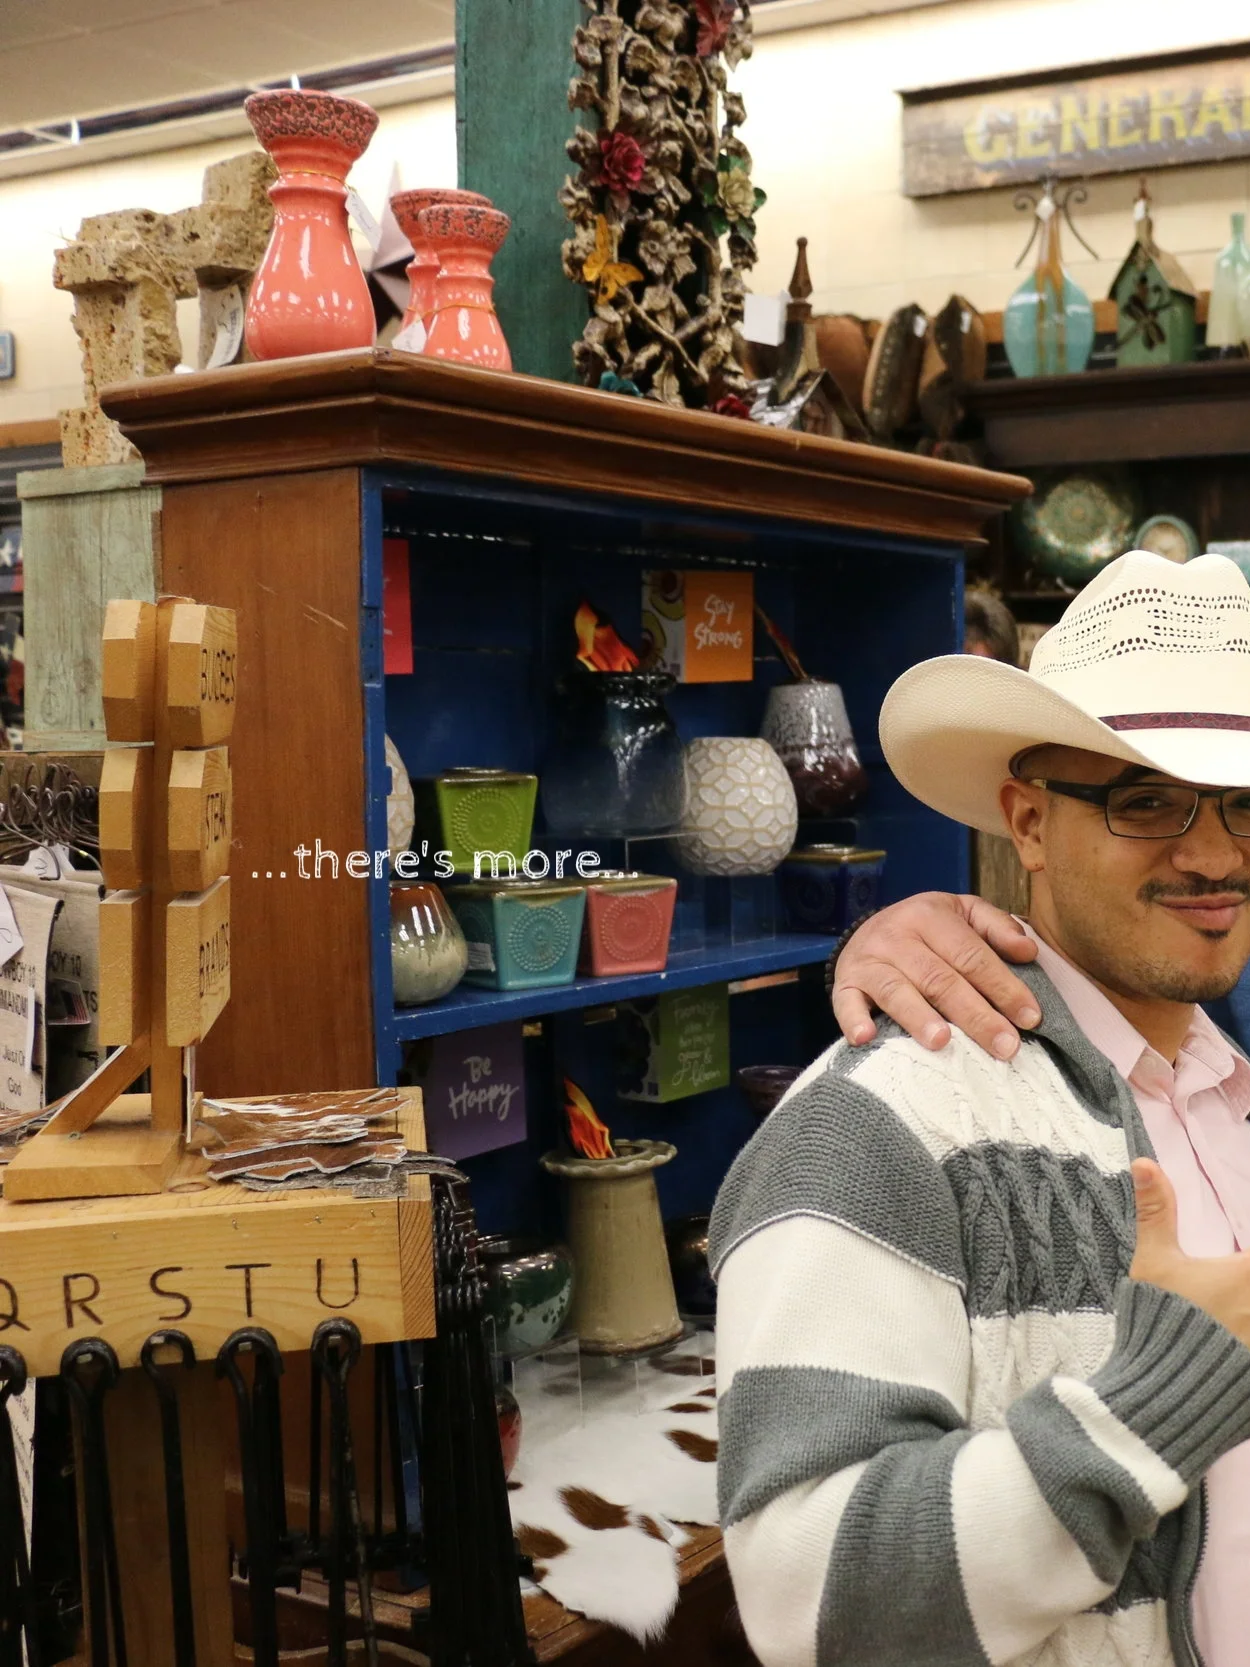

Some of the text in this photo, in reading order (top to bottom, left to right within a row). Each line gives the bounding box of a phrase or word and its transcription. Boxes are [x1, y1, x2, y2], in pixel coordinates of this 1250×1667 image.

[199, 922, 230, 999] BRANDS
[463, 1056, 492, 1083] Be
[448, 1081, 520, 1122] Happy
[63, 1272, 103, 1329] R
[149, 1266, 193, 1321] S
[225, 1263, 272, 1318] T
[316, 1258, 360, 1309] U
